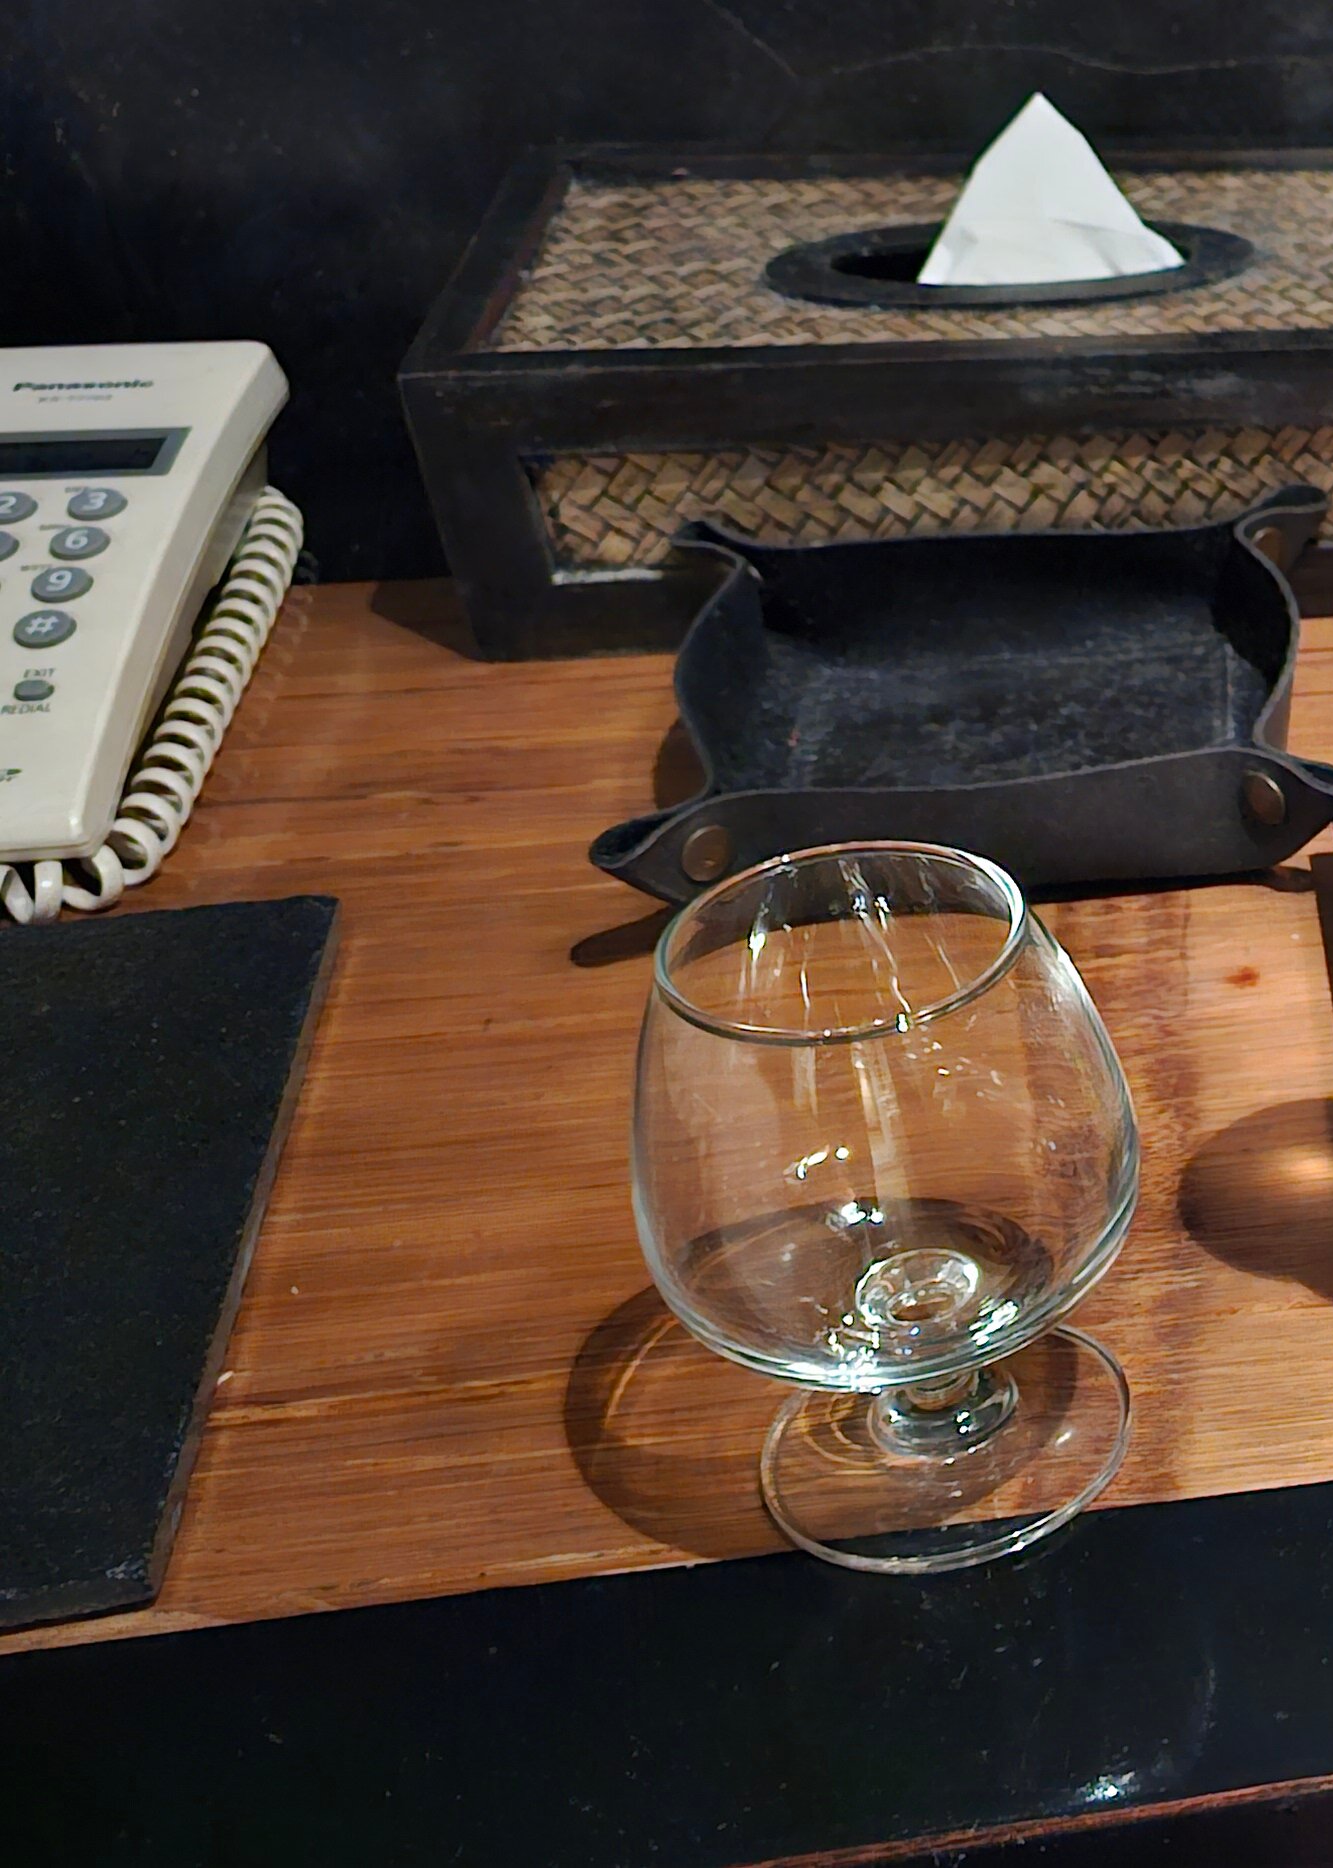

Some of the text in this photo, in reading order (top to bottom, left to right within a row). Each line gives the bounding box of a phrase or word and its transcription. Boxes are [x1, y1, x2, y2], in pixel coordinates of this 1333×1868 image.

[13, 378, 154, 392] Panasonic
[81, 491, 108, 512] 3
[65, 529, 89, 550] 6
[46, 569, 73, 592] 9
[23, 668, 56, 679] EXIT
